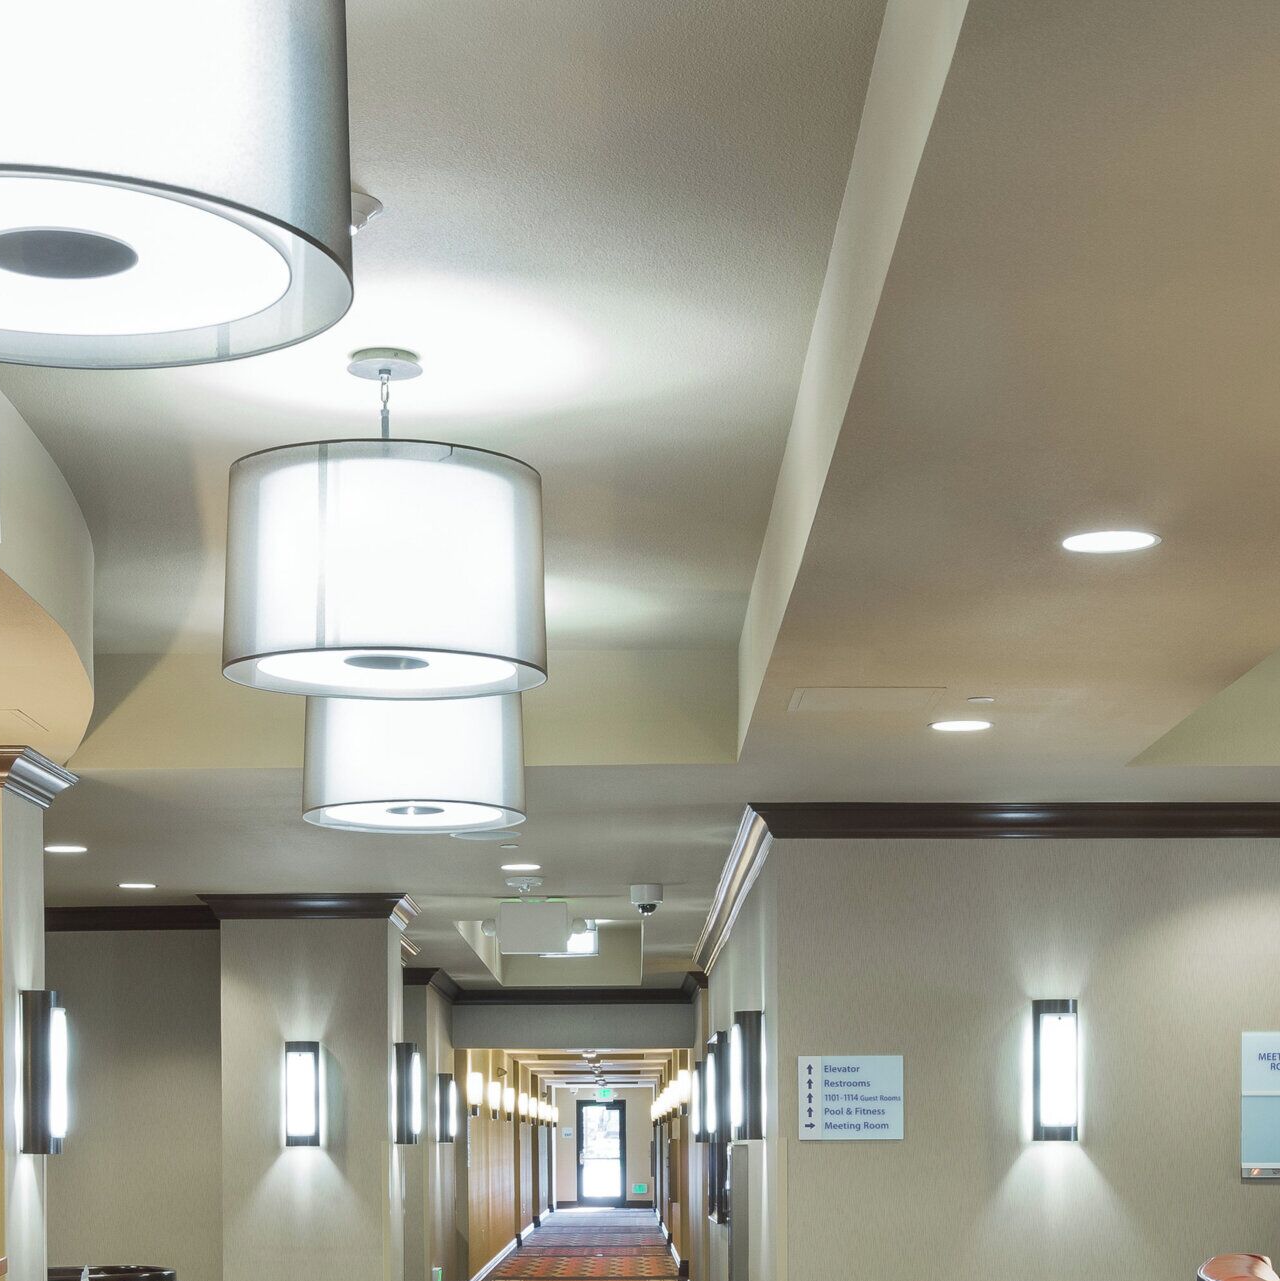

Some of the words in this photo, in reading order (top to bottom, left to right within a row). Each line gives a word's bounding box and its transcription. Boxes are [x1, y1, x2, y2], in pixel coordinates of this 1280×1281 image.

[824, 1065, 860, 1073] Elevator
[824, 1079, 871, 1088] Restrooms
[824, 1107, 844, 1116] Pool
[845, 1107, 853, 1116] &
[855, 1107, 886, 1116] Fitness
[824, 1122, 861, 1132] Meeting
[863, 1122, 889, 1130] Room
